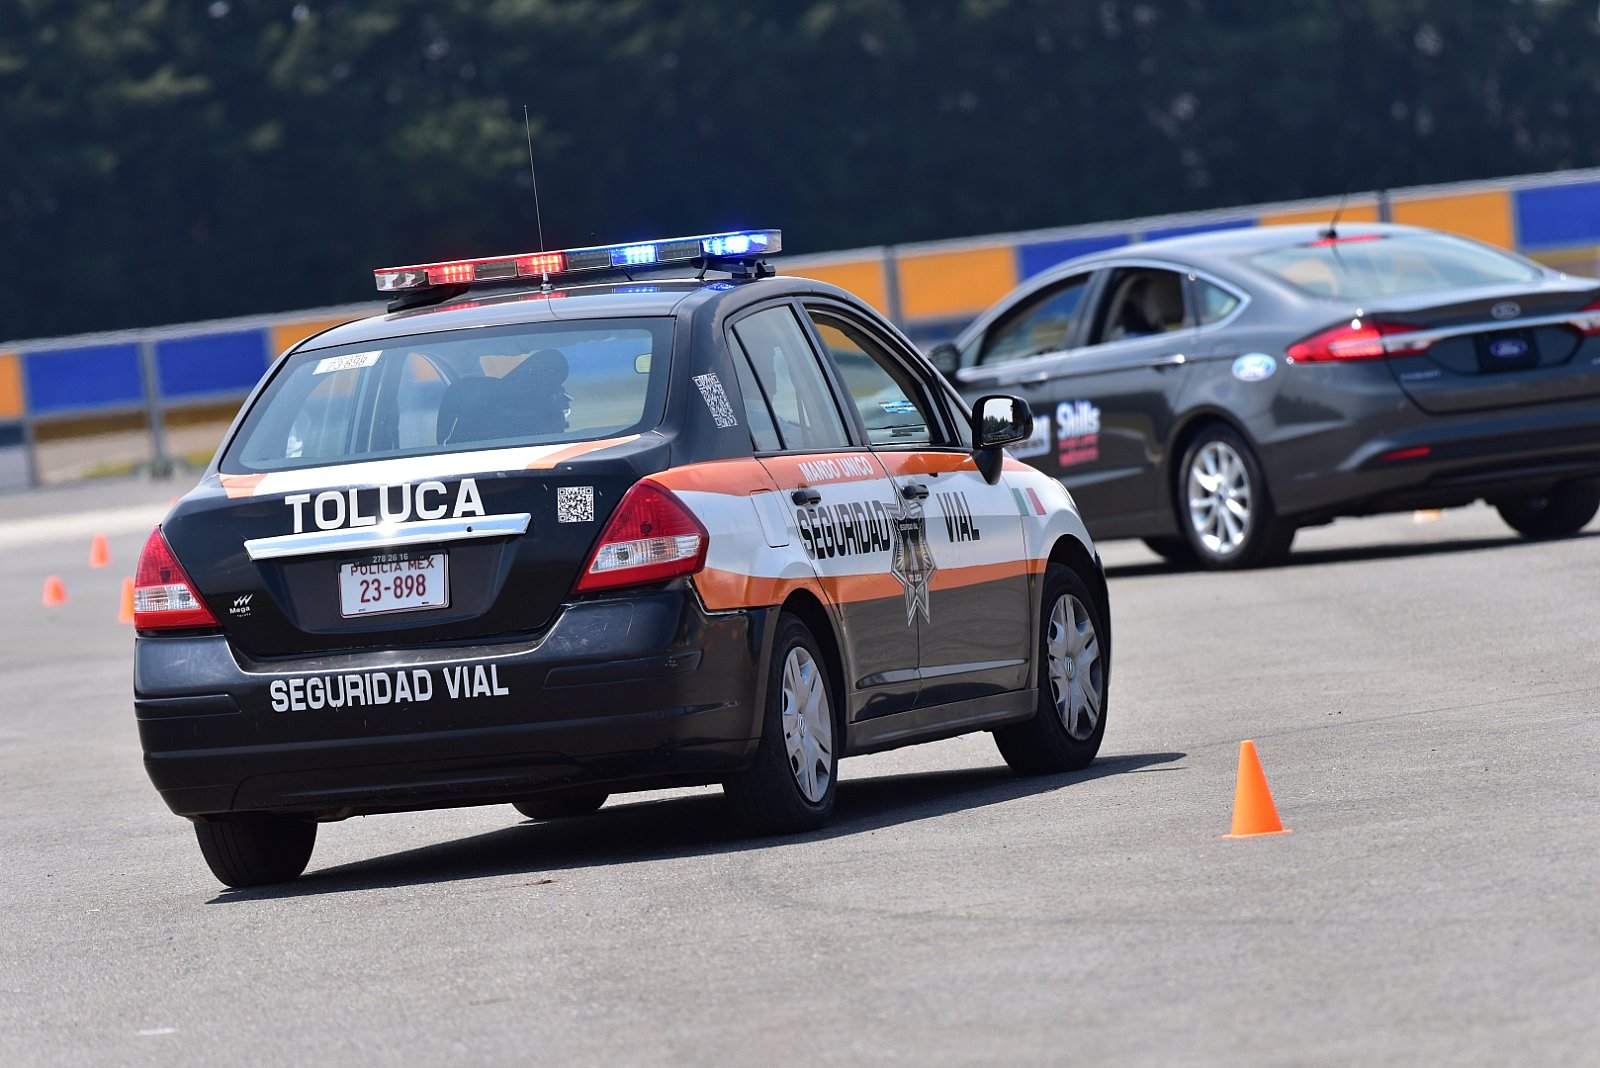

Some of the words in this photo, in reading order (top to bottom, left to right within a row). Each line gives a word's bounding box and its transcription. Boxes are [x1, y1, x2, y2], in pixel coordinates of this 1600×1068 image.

[798, 459, 842, 482] MANDO
[836, 455, 875, 477] UNICO
[285, 478, 486, 534] TOLUCA
[796, 499, 891, 561] SEGURIDAD
[935, 491, 981, 543] VIAL
[350, 560, 403, 577] POLICIA
[407, 557, 435, 571] MEX
[372, 555, 387, 563] 278
[387, 554, 398, 562] 26
[399, 553, 409, 561] 16
[360, 573, 426, 604] 23-898
[229, 606, 251, 614] Mega
[269, 668, 433, 713] SEGURIDAD
[443, 663, 510, 699] VIAL
